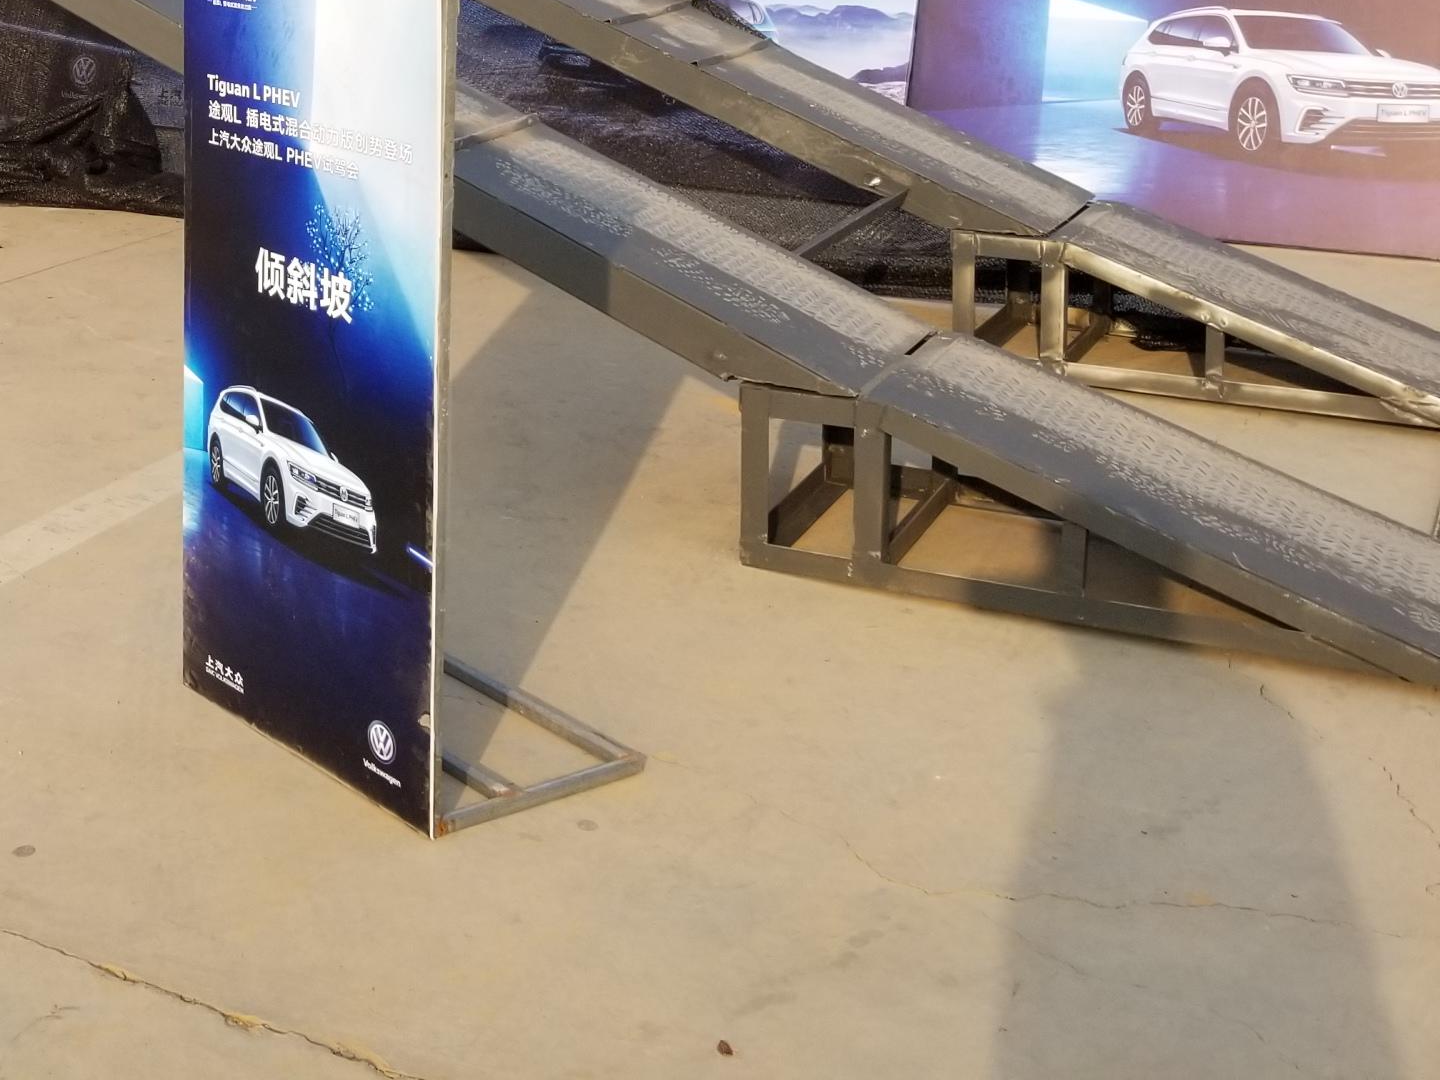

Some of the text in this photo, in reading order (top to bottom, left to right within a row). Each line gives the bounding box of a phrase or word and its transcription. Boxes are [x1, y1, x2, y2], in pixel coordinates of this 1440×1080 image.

[207, 74, 300, 108] Tiguan L PHEV
[208, 100, 242, 124] 途观L
[208, 127, 283, 161] 上汽大众途观L
[255, 247, 353, 324] 倾斜坡
[205, 655, 244, 687] 上汽大众
